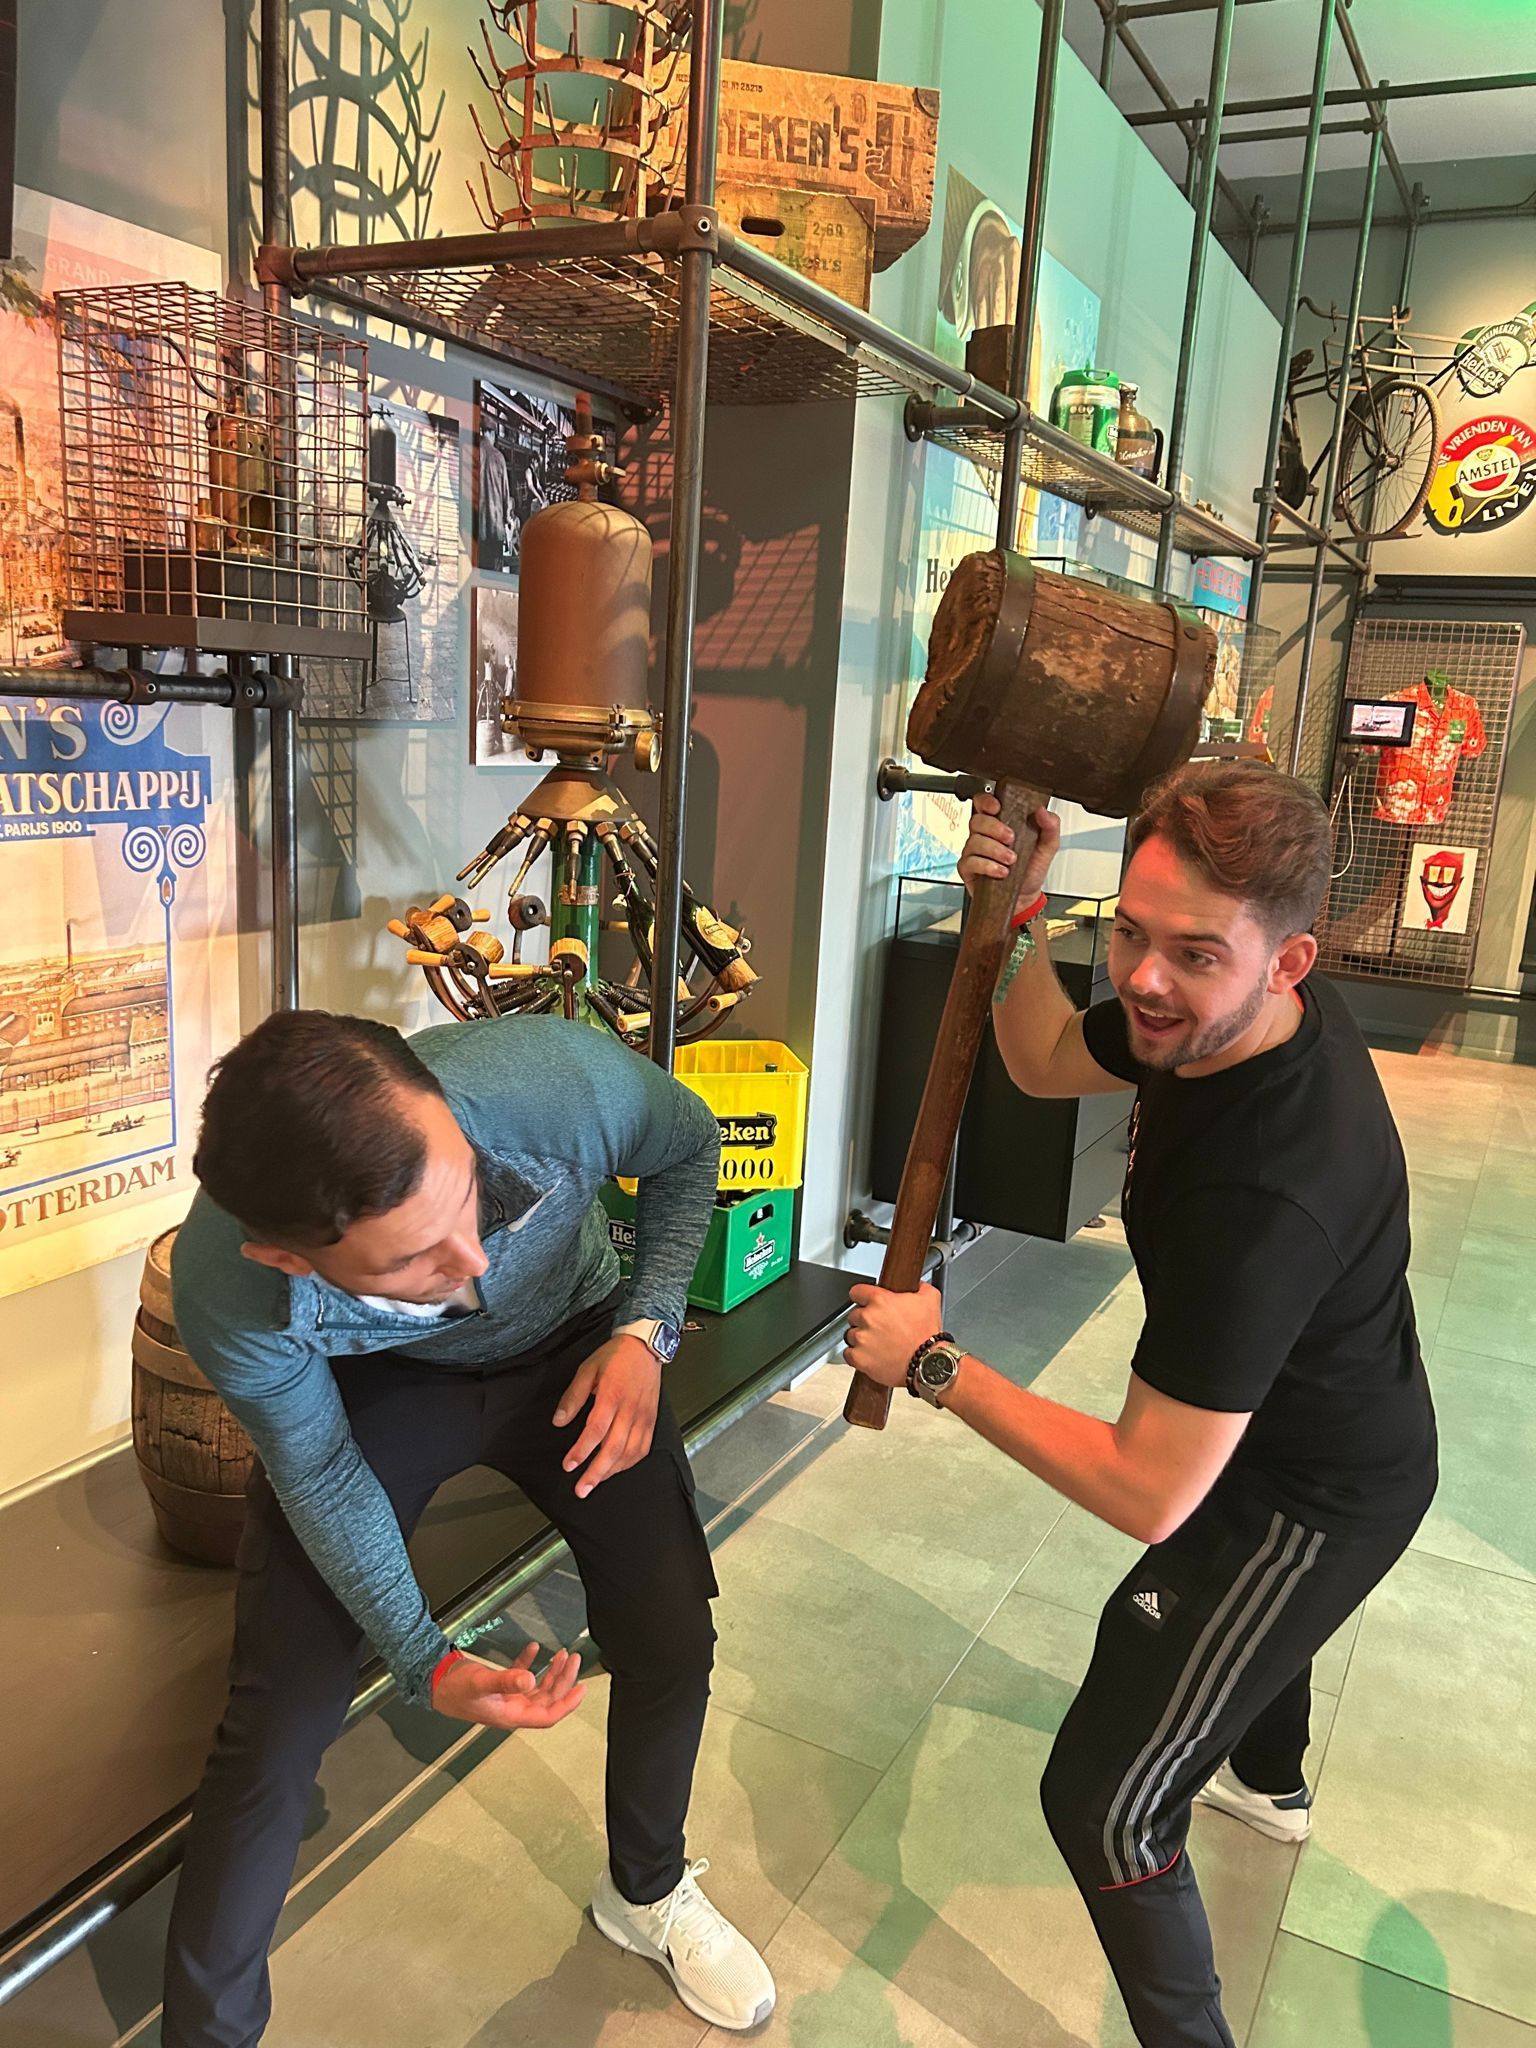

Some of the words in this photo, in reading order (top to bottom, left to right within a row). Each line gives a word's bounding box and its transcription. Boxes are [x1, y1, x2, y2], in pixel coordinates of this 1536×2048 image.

[716, 105, 860, 173] NEKEN'S
[44, 254, 111, 288] GRAND
[1480, 322, 1521, 345] HEINEKEN
[1445, 420, 1508, 452] VRIENDEN
[1509, 424, 1534, 449] VAN
[1458, 457, 1518, 484] AMSTEL
[52, 820, 82, 834] 1900
[722, 1158, 774, 1180] 000
[1132, 1594, 1162, 1620] adidas
